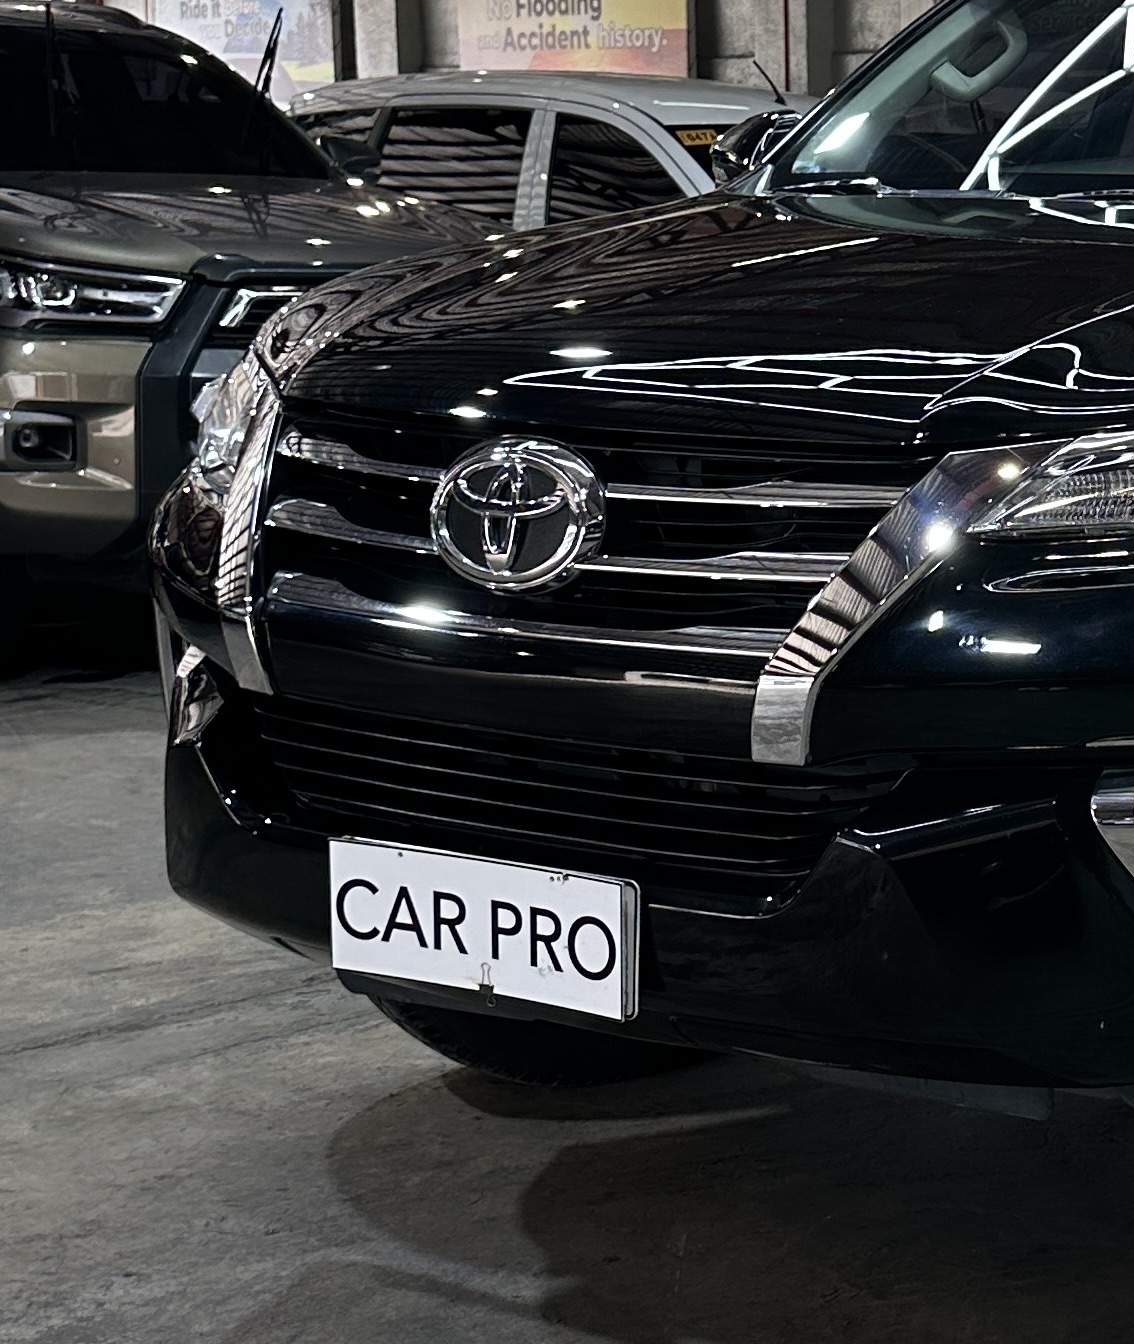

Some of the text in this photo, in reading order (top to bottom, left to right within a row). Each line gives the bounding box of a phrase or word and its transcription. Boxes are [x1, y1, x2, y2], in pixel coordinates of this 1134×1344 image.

[224, 17, 271, 38] Decide
[502, 23, 591, 51] Accident
[598, 20, 668, 52] history.
[335, 877, 617, 982] CAR PRO
